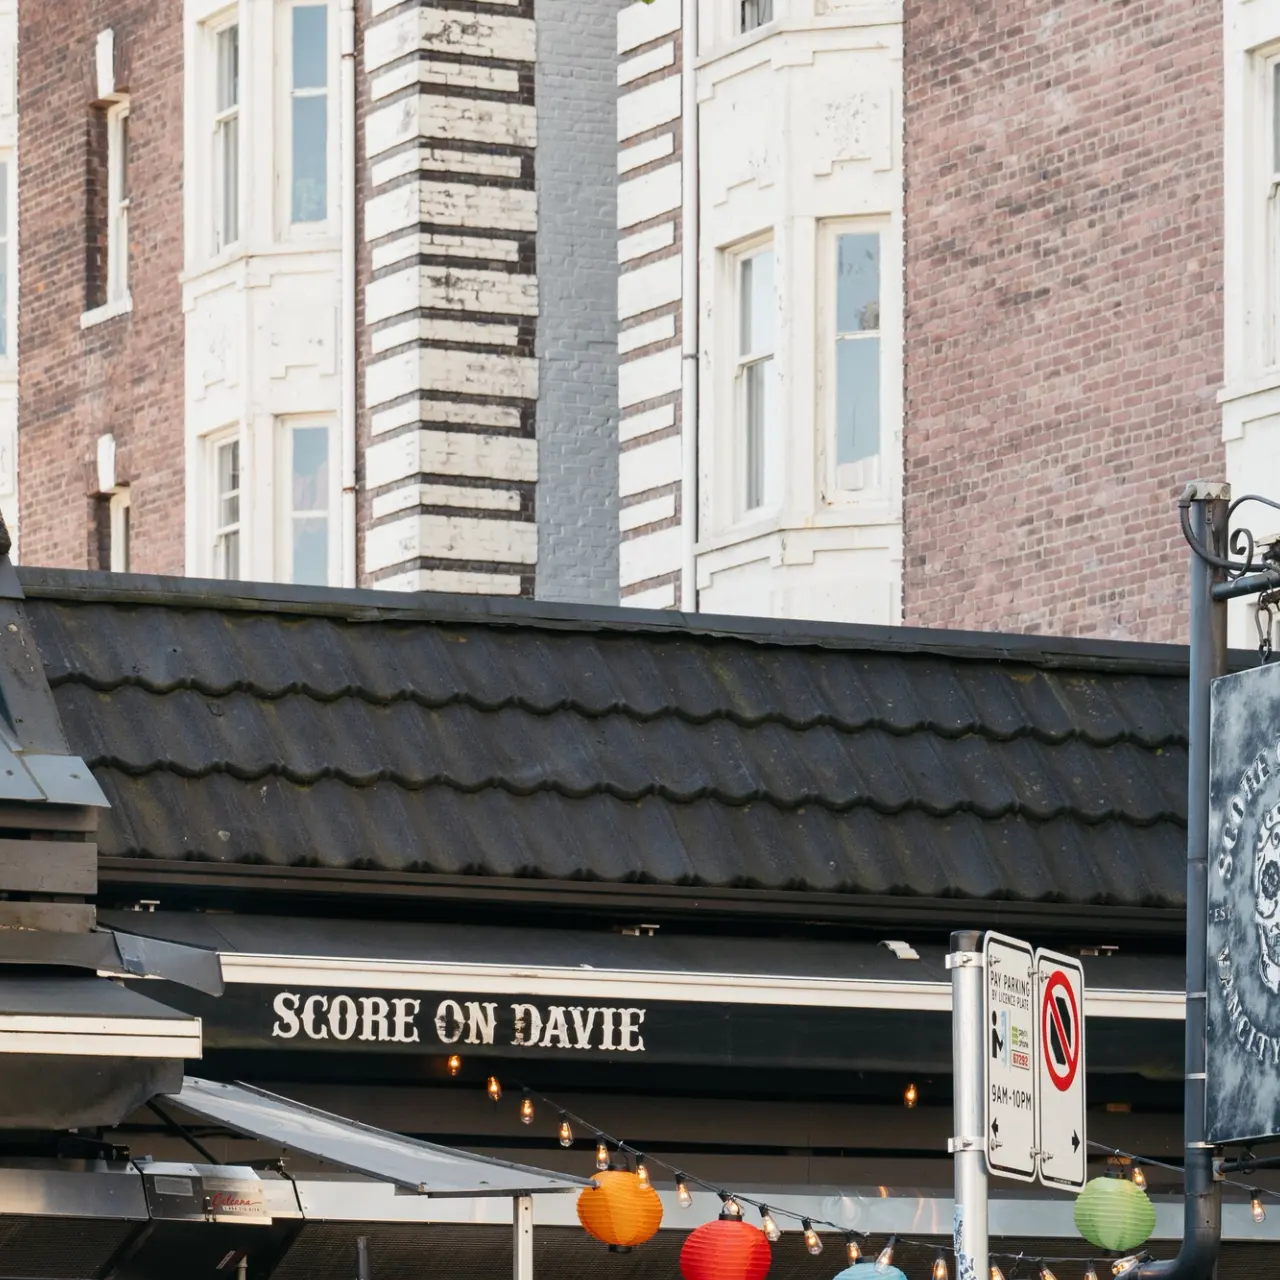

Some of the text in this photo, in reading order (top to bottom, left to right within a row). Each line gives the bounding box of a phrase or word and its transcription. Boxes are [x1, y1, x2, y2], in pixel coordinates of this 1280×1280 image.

[1218, 748, 1270, 880] SCORE
[990, 970, 1031, 997] PAY PARKING
[272, 992, 646, 1052] SCORE ON DAVIE
